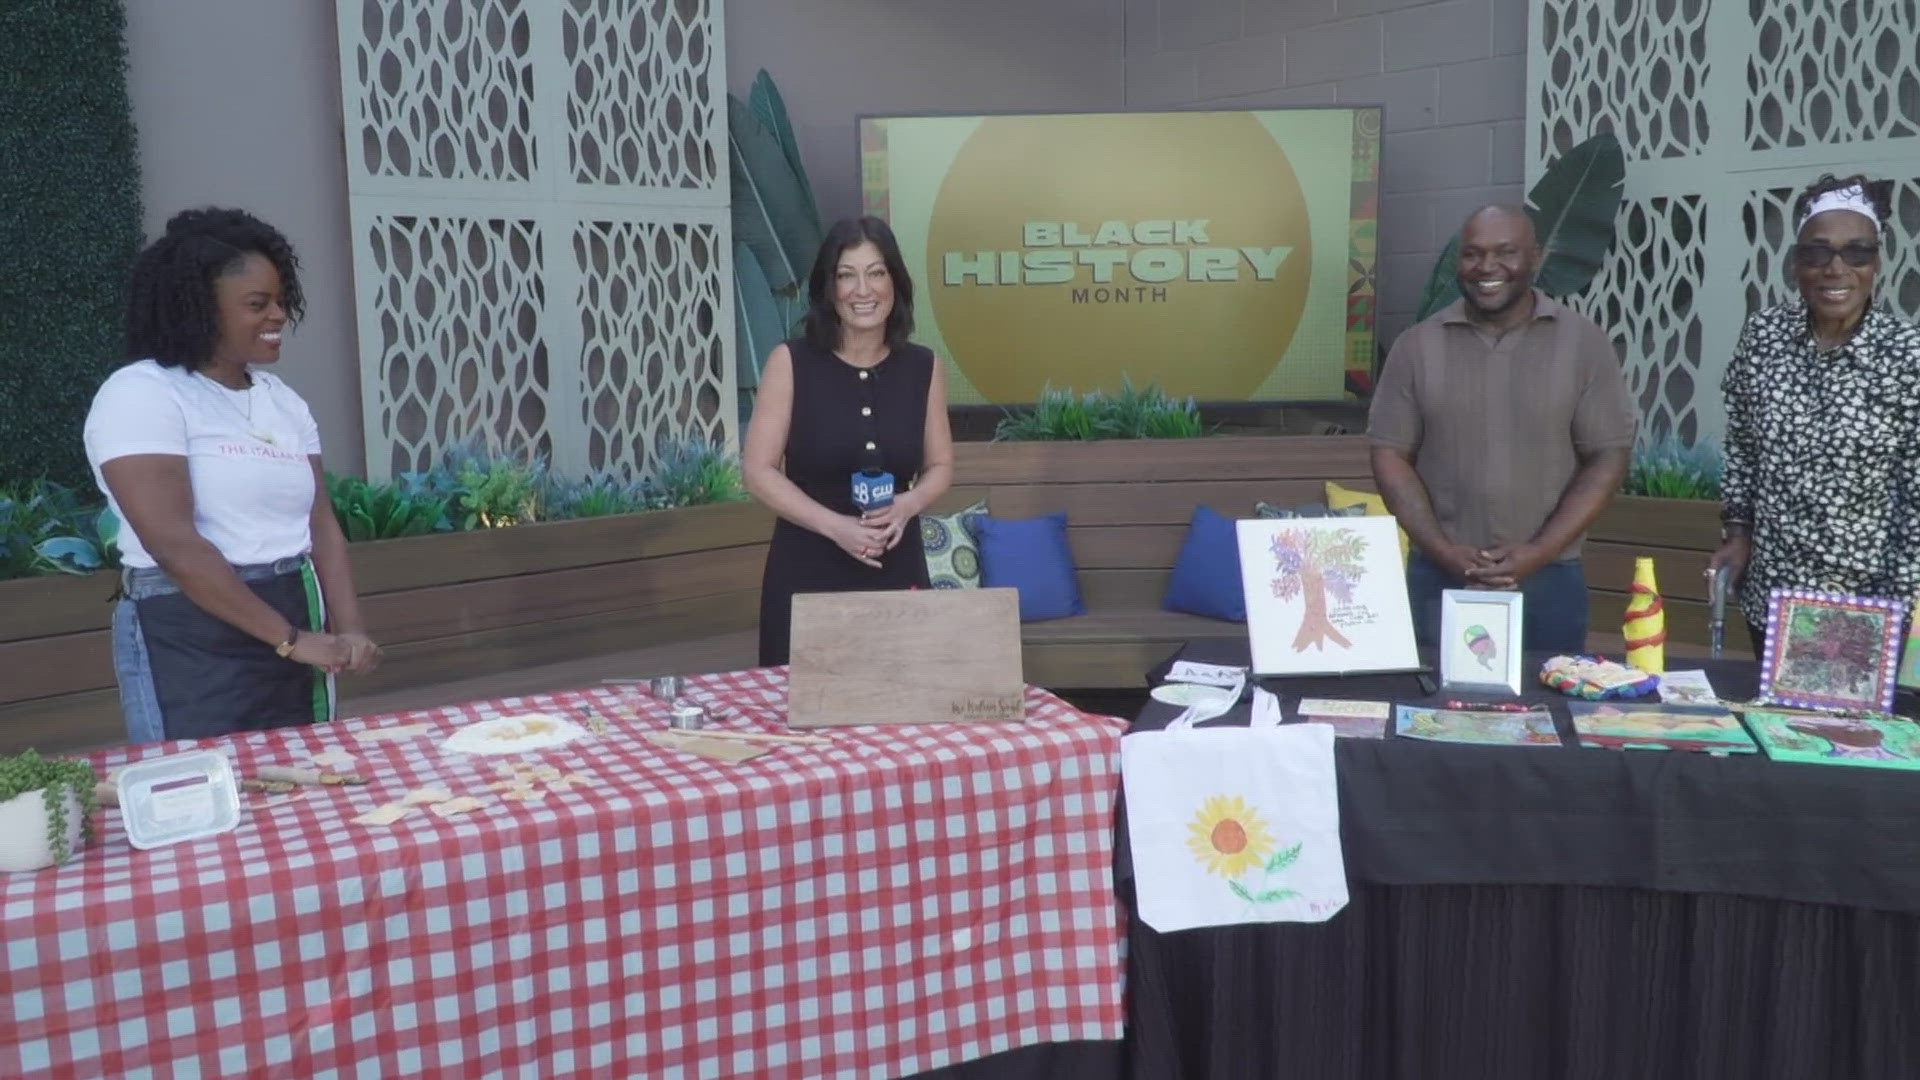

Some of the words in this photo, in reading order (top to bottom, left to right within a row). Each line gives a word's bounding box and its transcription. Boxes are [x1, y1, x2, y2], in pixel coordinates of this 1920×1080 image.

[1023, 219, 1210, 248] BLACK
[943, 246, 1295, 286] HISTORY
[1072, 287, 1167, 304] MONTH
[218, 444, 247, 456] THE
